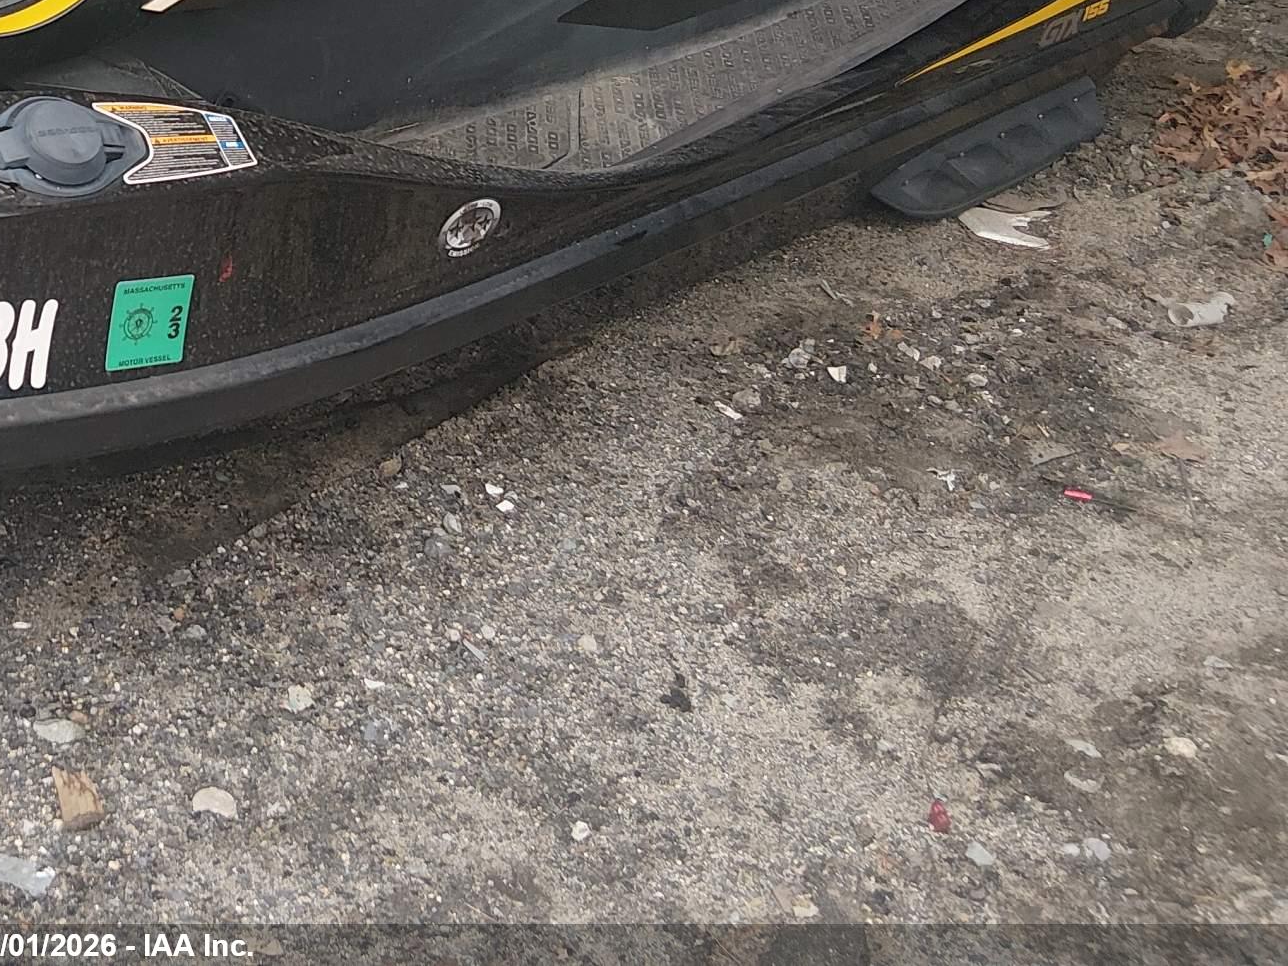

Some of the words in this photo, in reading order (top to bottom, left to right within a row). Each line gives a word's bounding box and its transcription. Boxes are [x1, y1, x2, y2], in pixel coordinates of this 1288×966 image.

[1037, 8, 1084, 48] GTX
[124, 282, 185, 295] MASSACHUSETTS
[119, 356, 143, 367] MOTOR
[145, 354, 171, 364] VESSEL
